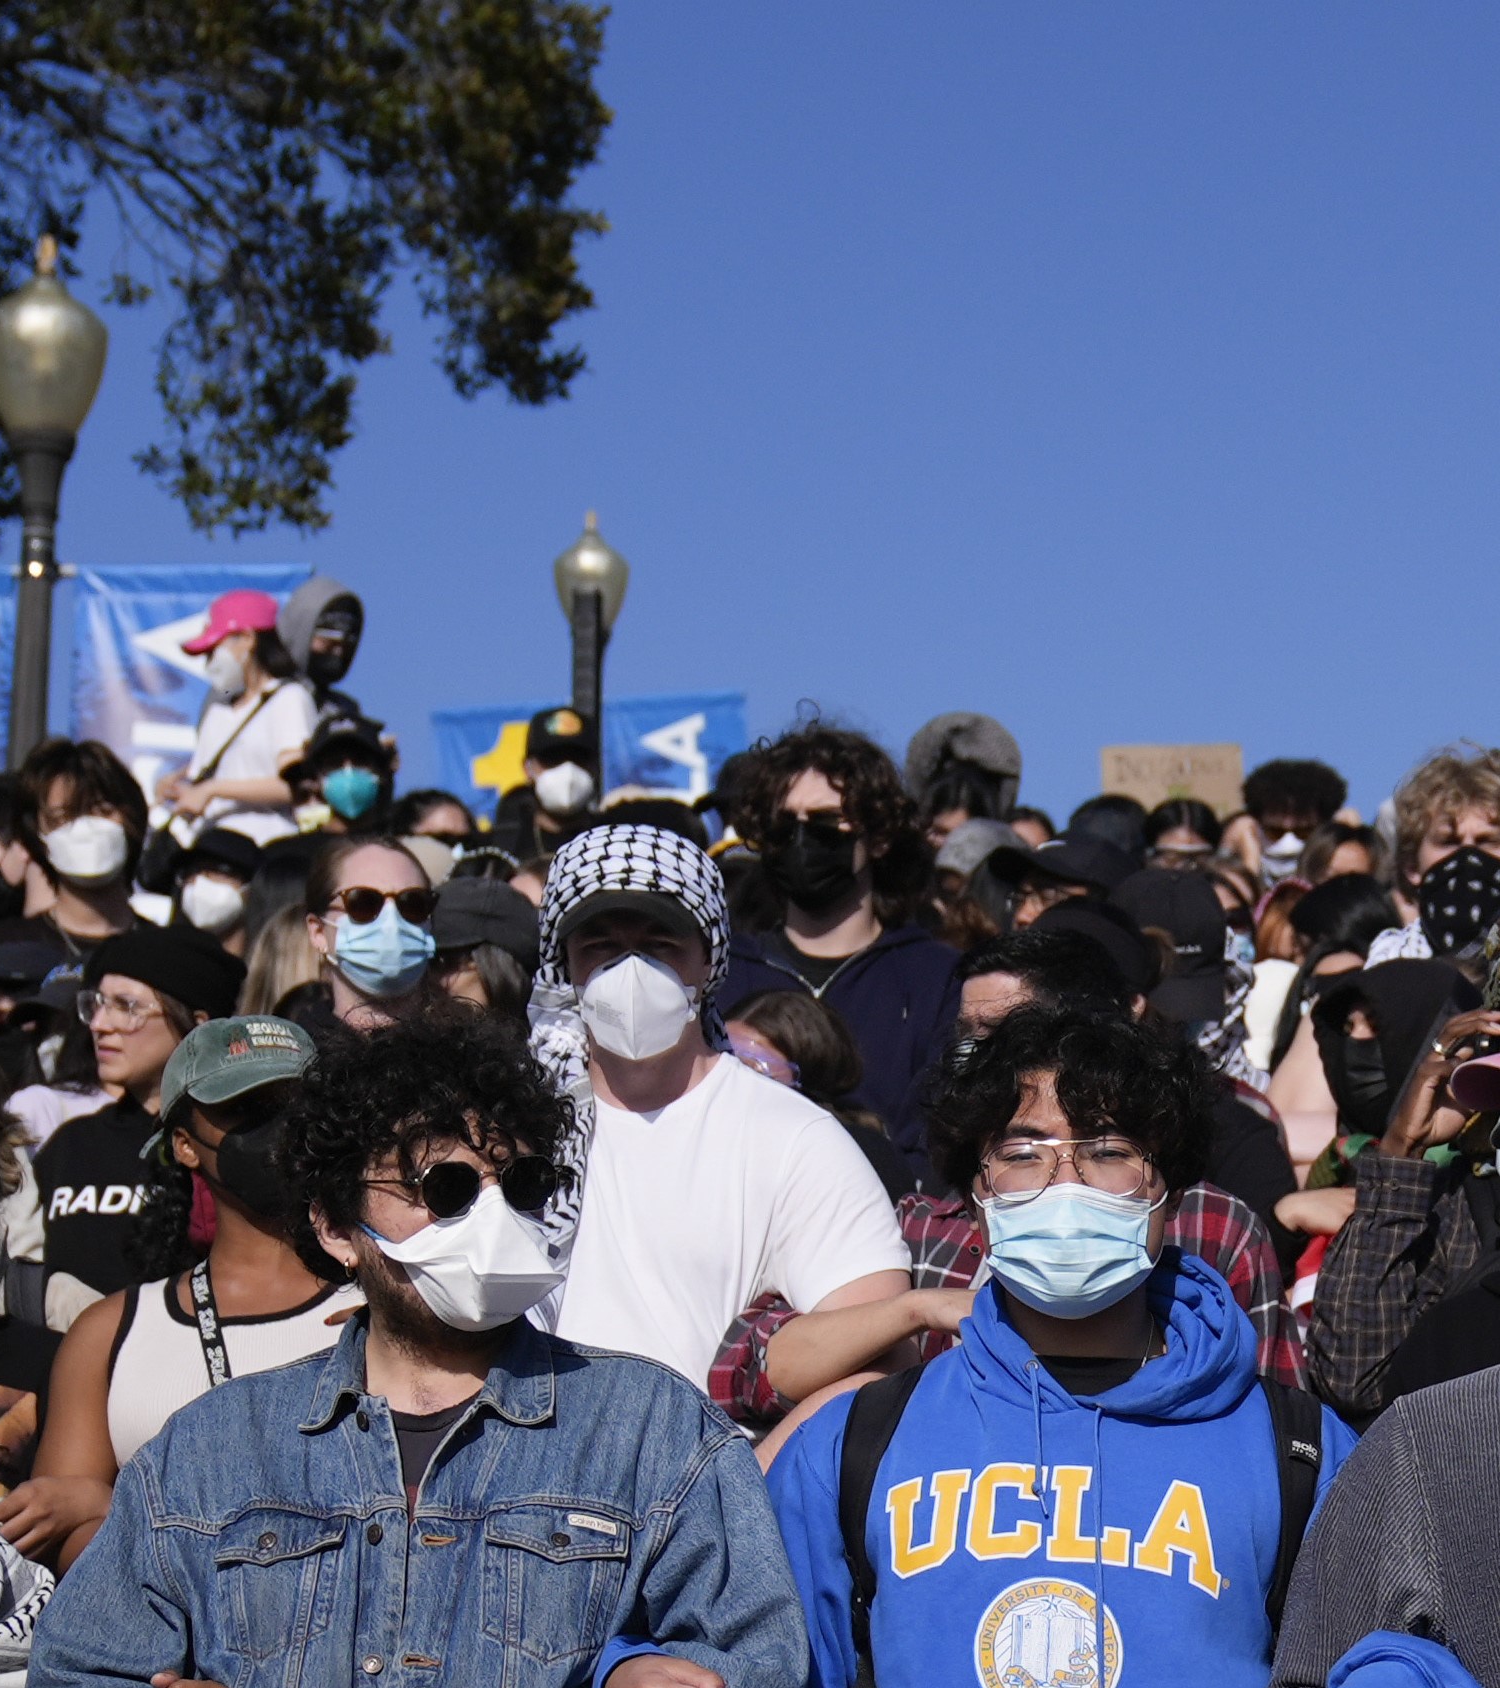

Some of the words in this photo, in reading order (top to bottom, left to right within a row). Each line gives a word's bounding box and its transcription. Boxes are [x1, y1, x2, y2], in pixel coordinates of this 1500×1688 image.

[885, 1462, 1221, 1600] UCLA
[981, 1584, 1050, 1652] UNIVERSITY
[1062, 1587, 1085, 1601] OF
